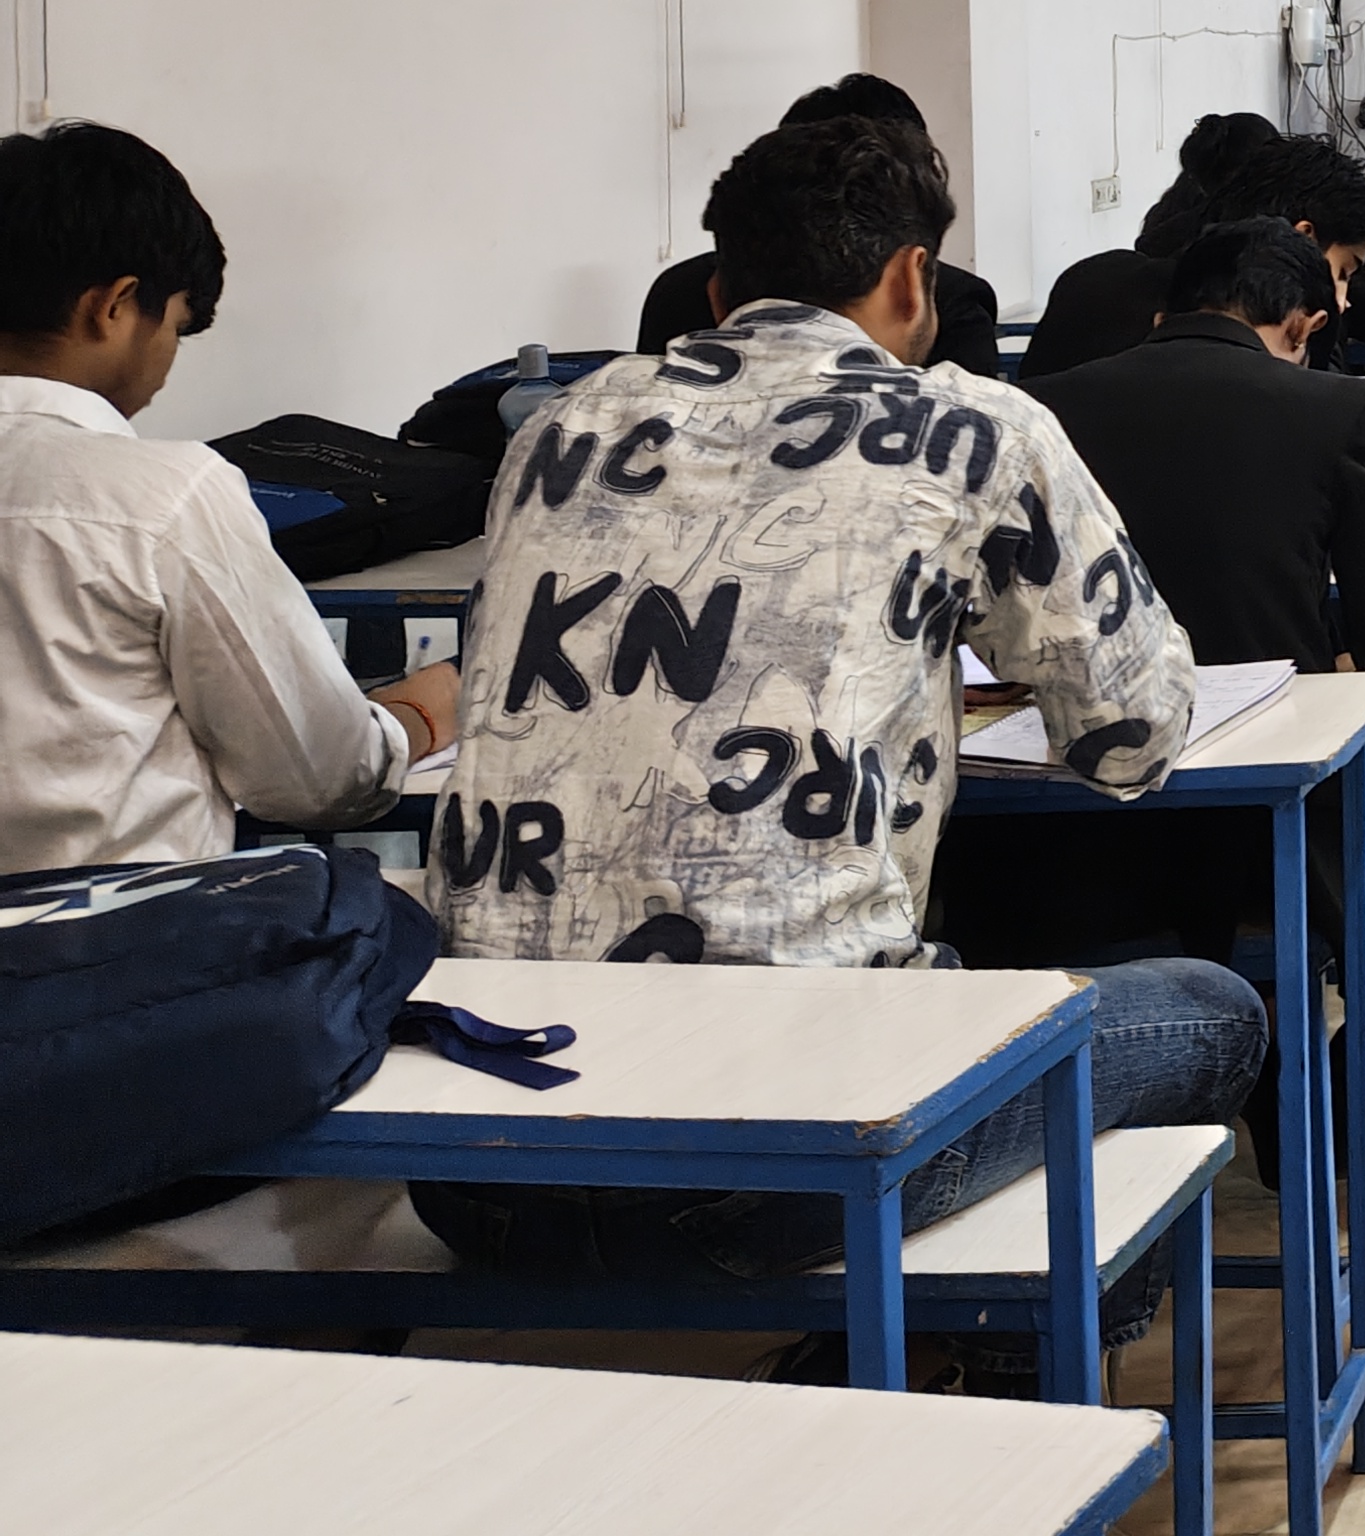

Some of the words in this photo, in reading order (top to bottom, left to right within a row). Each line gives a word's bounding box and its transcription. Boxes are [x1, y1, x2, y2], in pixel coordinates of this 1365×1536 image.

[512, 417, 678, 510] NC
[504, 570, 742, 706] KN
[440, 791, 566, 896] UR
